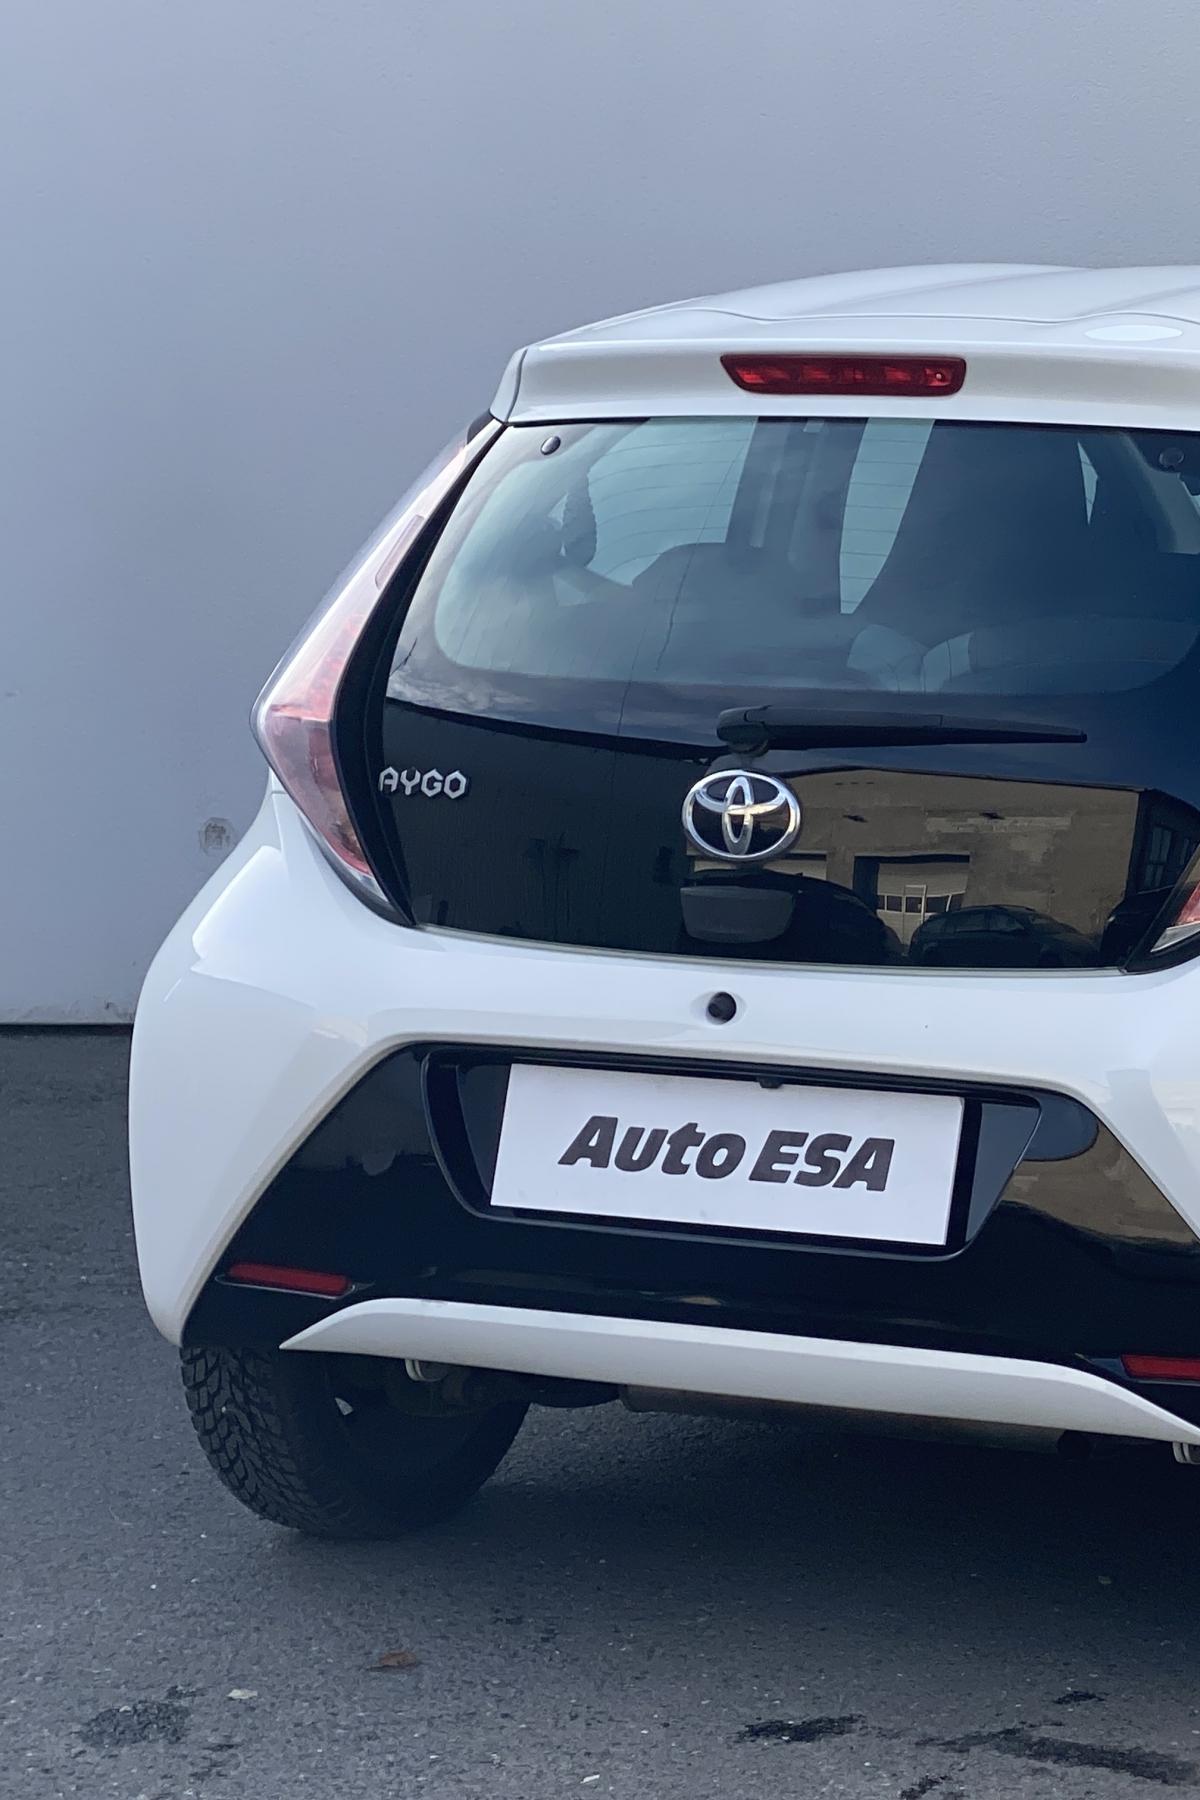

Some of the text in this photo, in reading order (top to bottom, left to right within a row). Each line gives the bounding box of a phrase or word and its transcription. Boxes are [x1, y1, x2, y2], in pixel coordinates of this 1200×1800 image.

[378, 766, 467, 799] AYGO
[558, 1115, 895, 1191] Auto ESA
